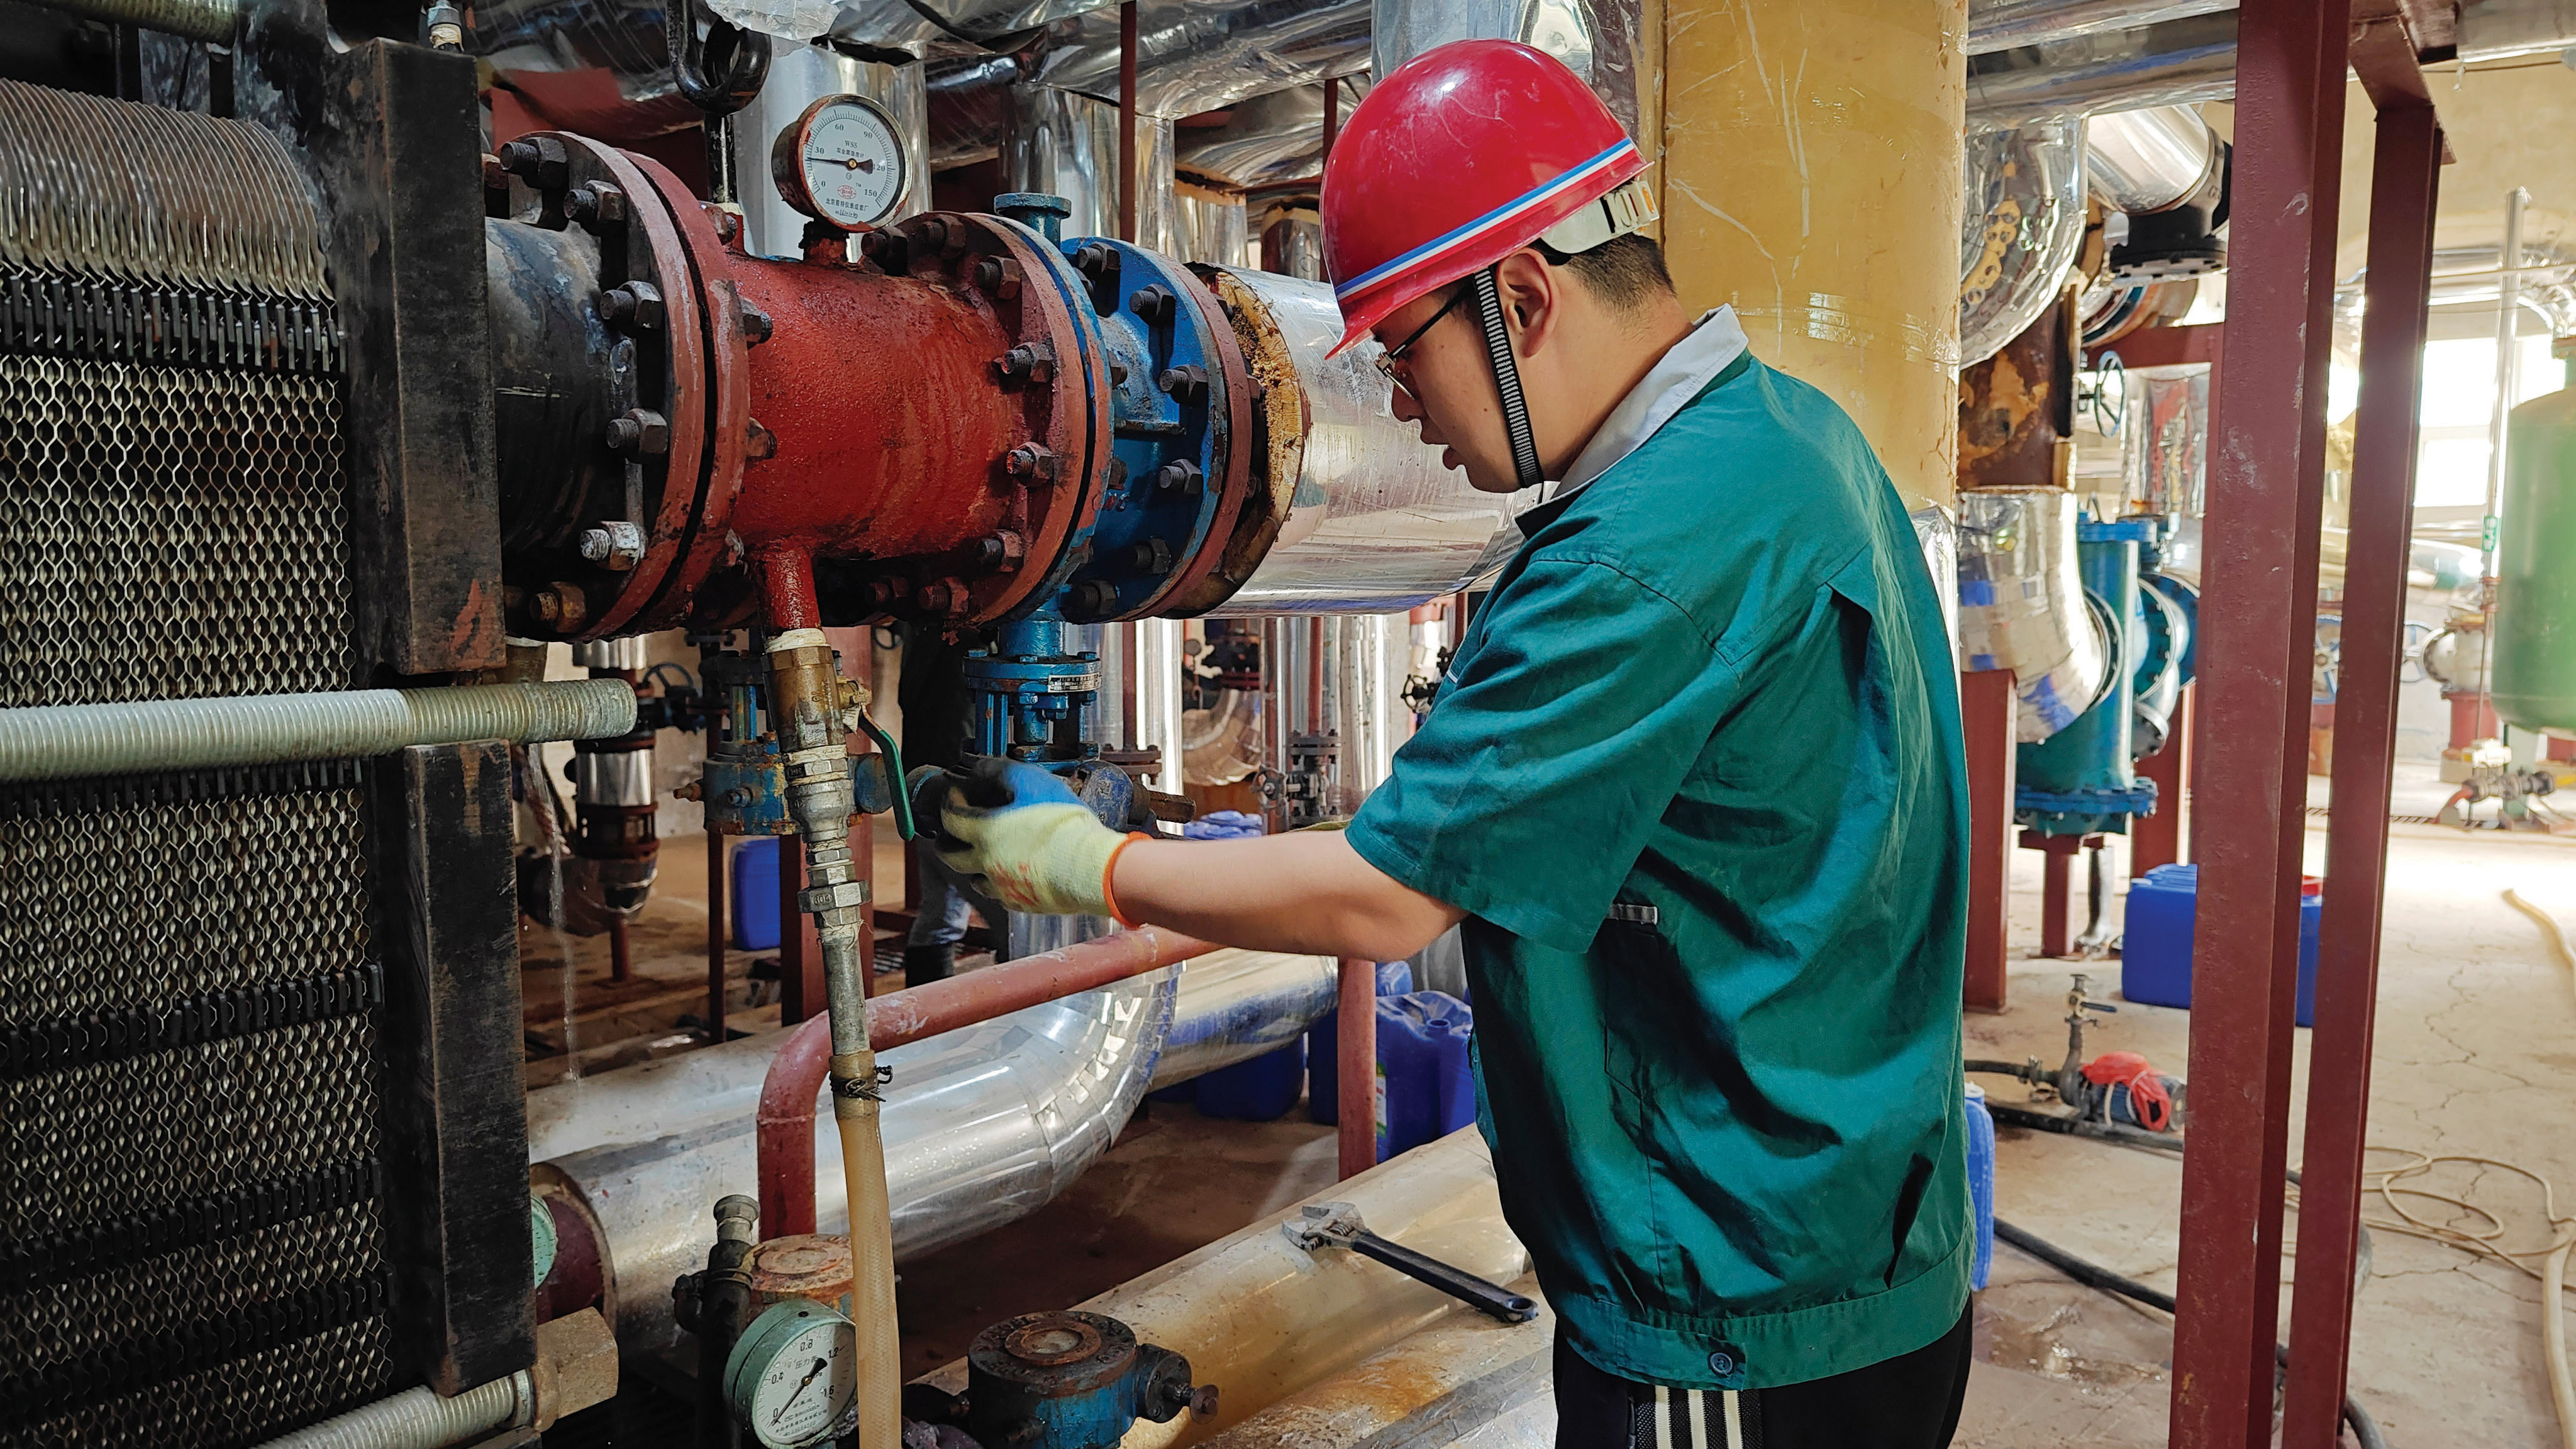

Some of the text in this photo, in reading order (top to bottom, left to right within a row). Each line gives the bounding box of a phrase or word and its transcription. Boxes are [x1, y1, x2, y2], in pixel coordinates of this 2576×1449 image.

[845, 140, 858, 148] WSS
[873, 163, 886, 172] 120
[864, 189, 877, 197] 150
[814, 894, 831, 905] 304
[800, 1339, 813, 1352] 0.8
[828, 1346, 839, 1359] 1.2
[794, 1356, 818, 1370] 压力表
[772, 1372, 784, 1384] 0.4
[823, 1385, 835, 1397] 1.6
[773, 1407, 779, 1418] 0
